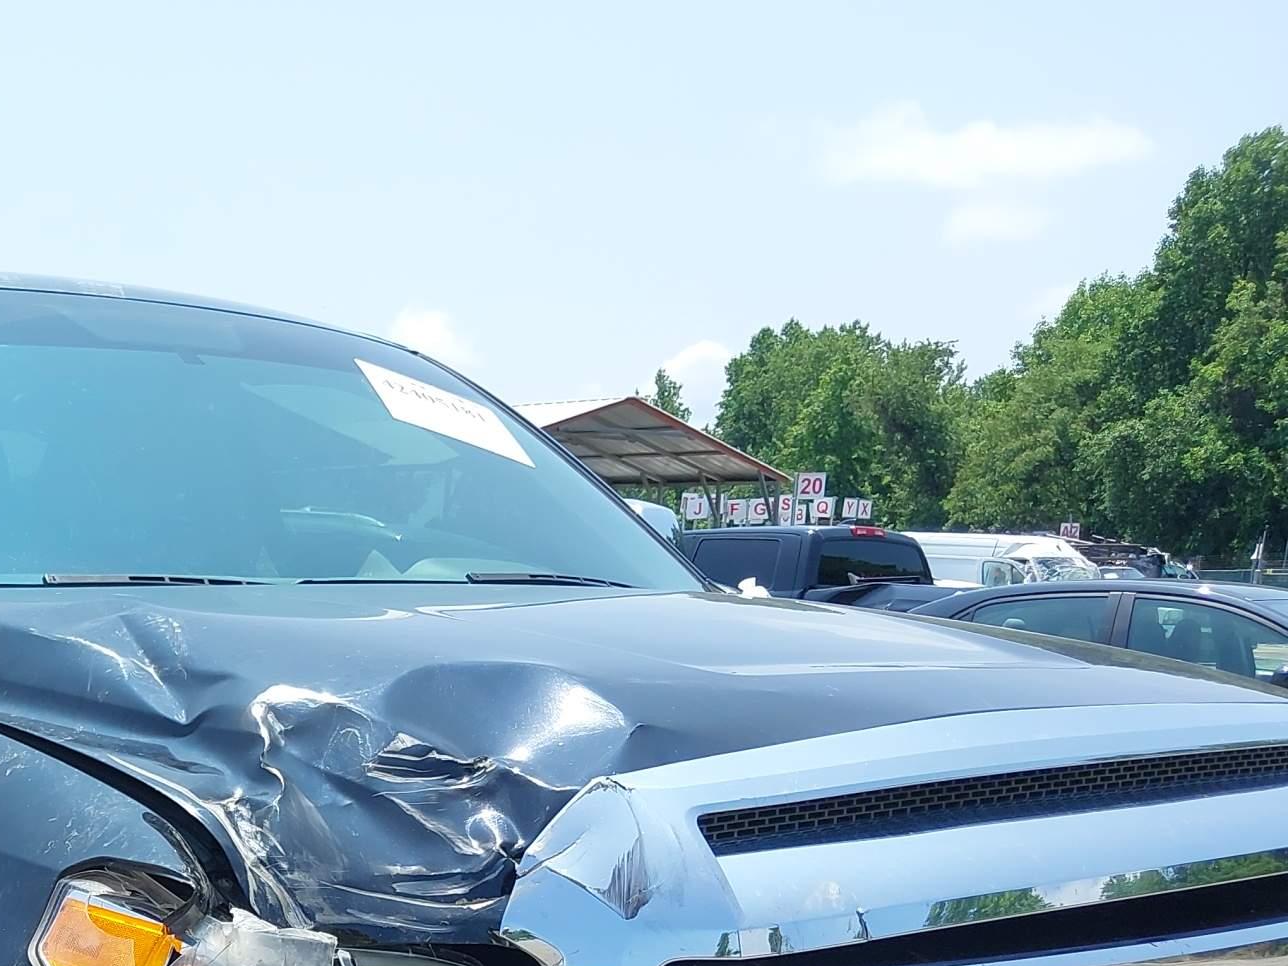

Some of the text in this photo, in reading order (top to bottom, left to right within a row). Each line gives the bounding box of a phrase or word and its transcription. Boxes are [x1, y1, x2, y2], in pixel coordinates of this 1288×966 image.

[799, 477, 823, 495] 20
[693, 502, 703, 516] J
[730, 503, 740, 516] F
[754, 502, 766, 516] G
[781, 497, 791, 511] S
[816, 500, 829, 515] Q
[846, 501, 855, 515] Y
[860, 502, 870, 516] X
